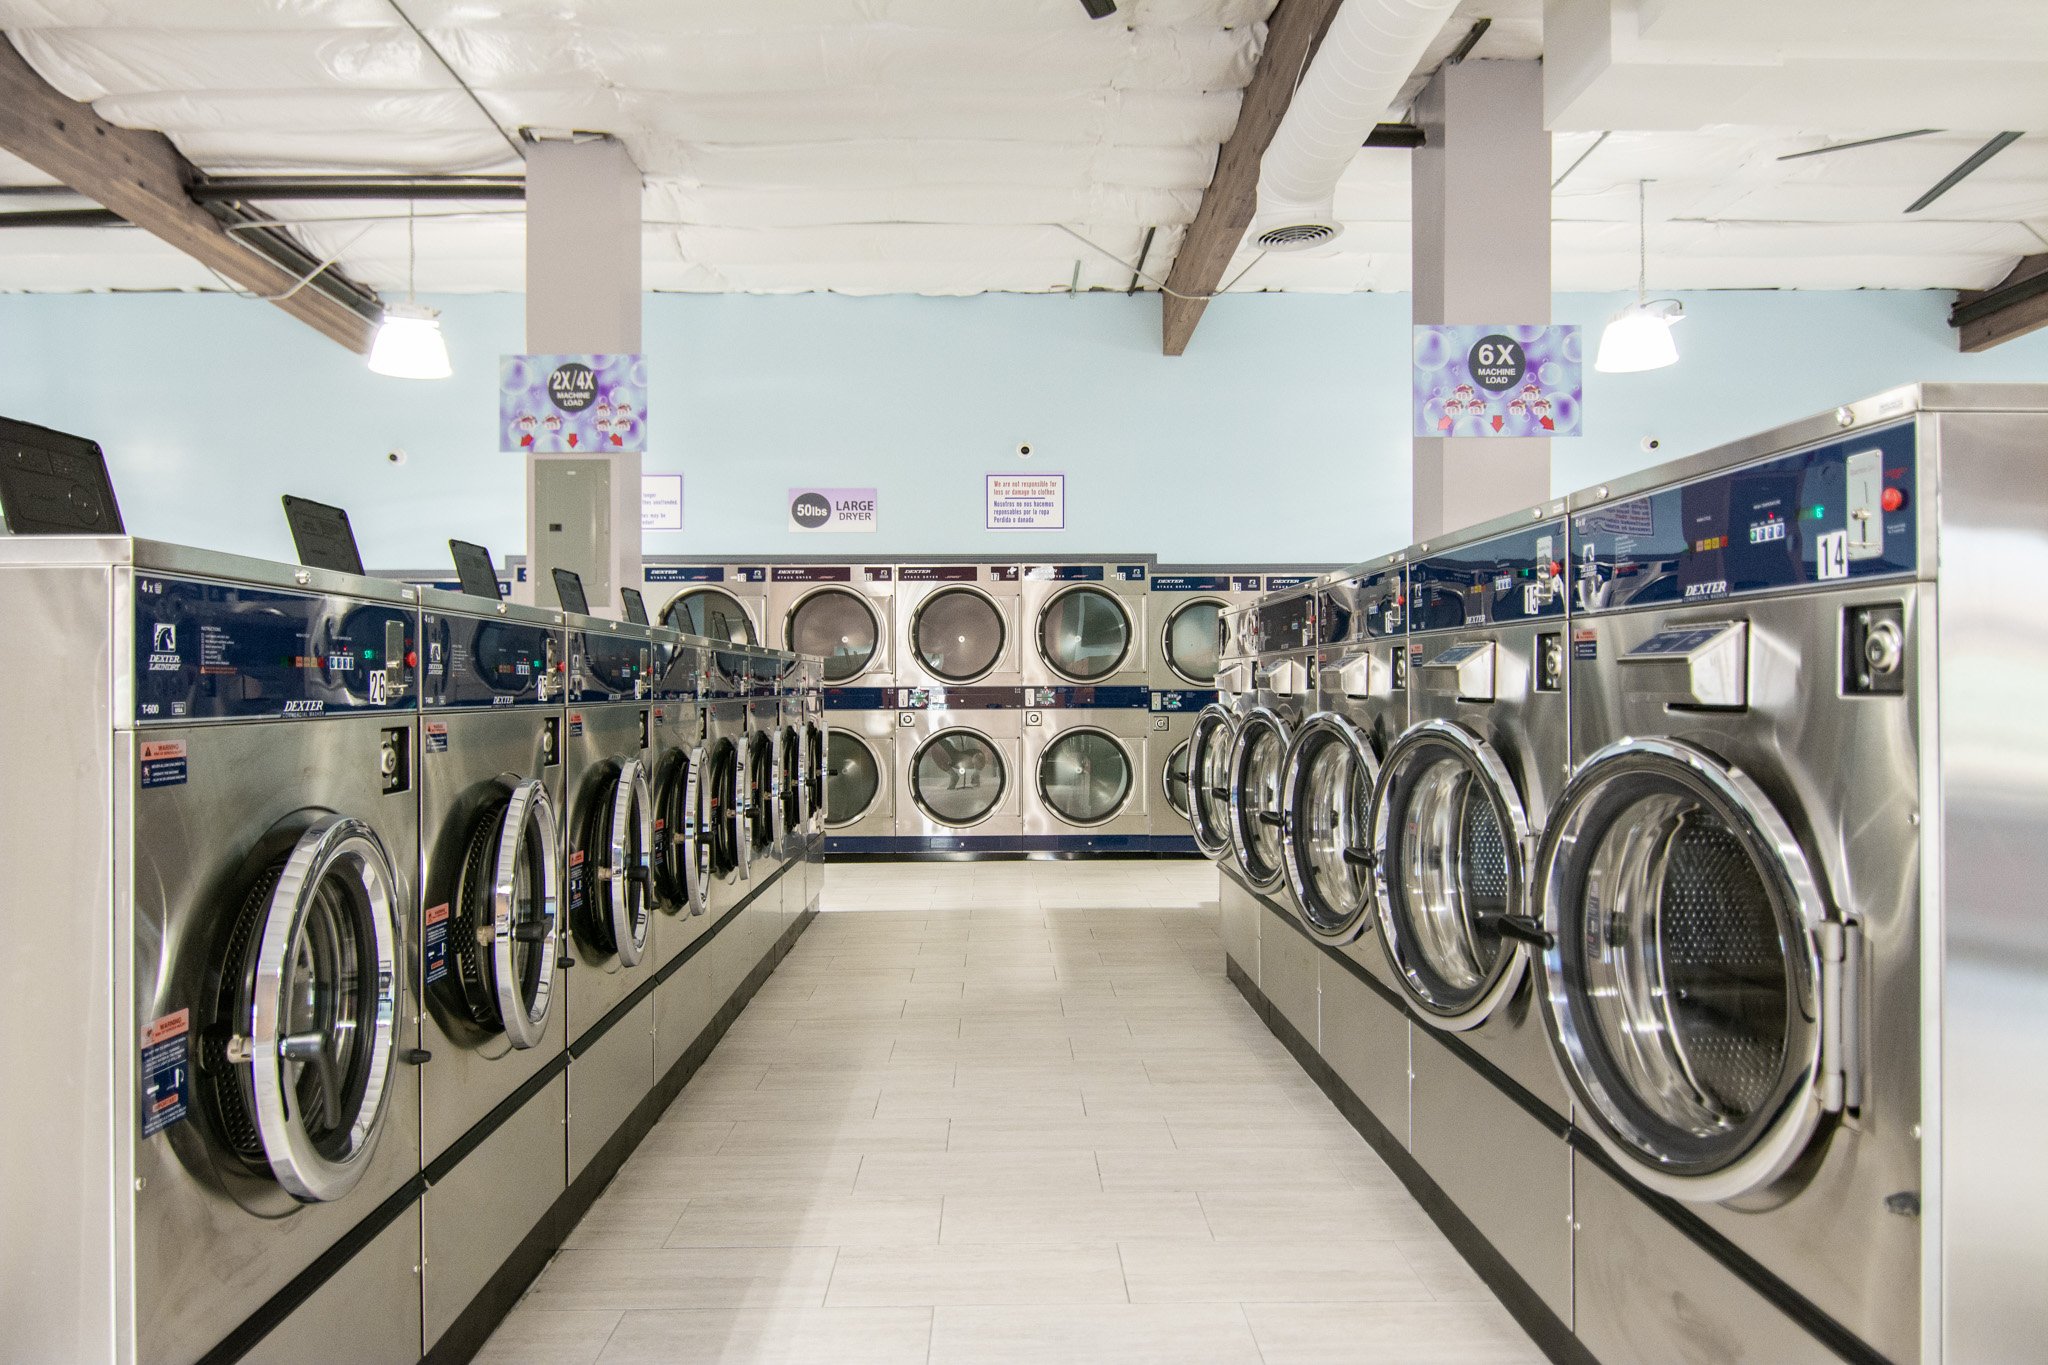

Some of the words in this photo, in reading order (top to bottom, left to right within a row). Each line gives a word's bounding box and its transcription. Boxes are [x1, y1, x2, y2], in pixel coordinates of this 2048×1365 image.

[1478, 344, 1515, 366] 6X
[1478, 368, 1516, 376] MACHINE
[553, 369, 594, 391] 2X/4X
[556, 391, 590, 399] MACHINE
[563, 399, 584, 407] LOAD
[797, 504, 828, 516] 50lbs
[836, 501, 874, 511] LARGE
[839, 512, 872, 521] DRYER
[1822, 535, 1845, 576] 14
[1685, 581, 1727, 597] DEXTER
[1465, 614, 1486, 625] DEXTER
[149, 655, 180, 663] DEXTER
[371, 672, 385, 703] 26
[493, 696, 514, 705] DEXTER
[142, 704, 160, 714] T-600
[284, 700, 324, 712] DEXTER
